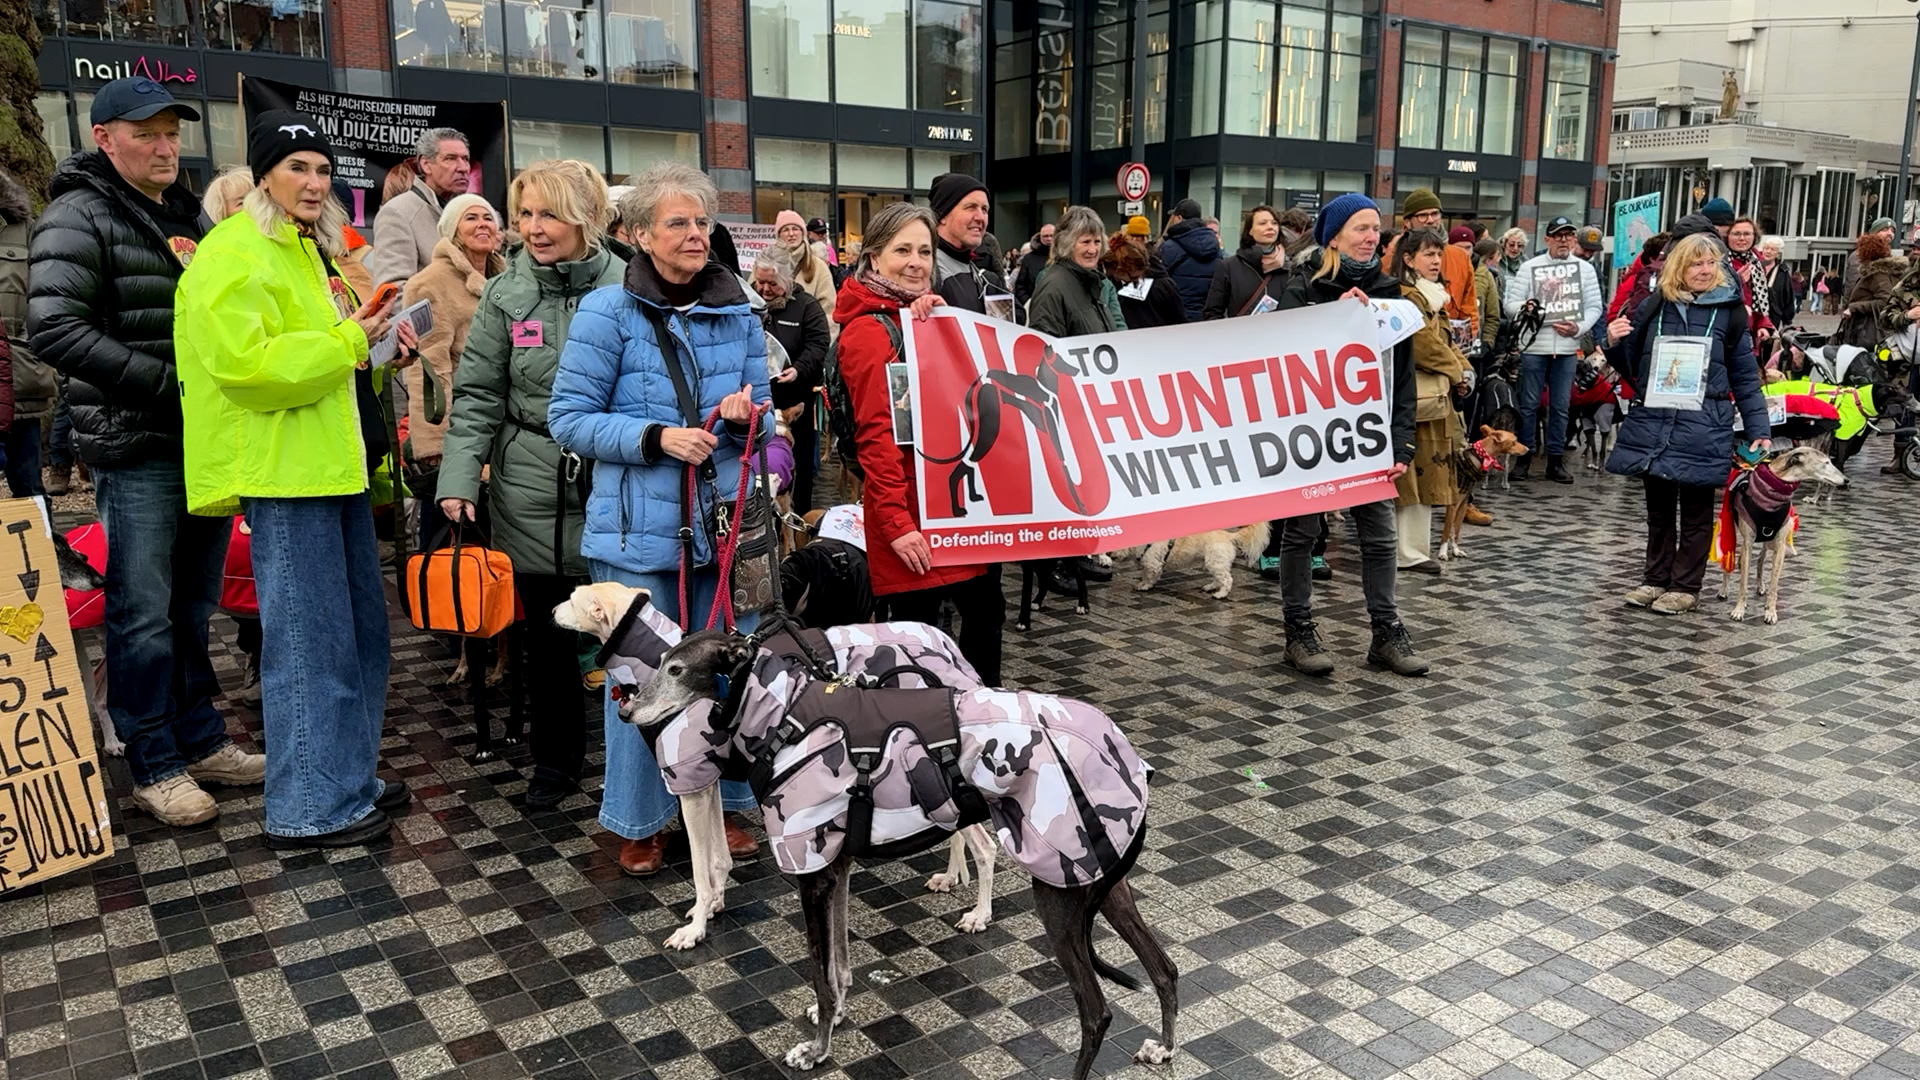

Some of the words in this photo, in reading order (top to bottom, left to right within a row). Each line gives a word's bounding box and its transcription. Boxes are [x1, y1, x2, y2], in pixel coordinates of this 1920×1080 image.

[296, 101, 346, 119] Eindigt
[348, 112, 370, 122] ook
[373, 114, 393, 125] het
[396, 116, 429, 127] leven
[298, 91, 316, 103] ALS
[318, 93, 336, 106] HET
[338, 96, 402, 115] JACHTSEIZOEN
[403, 104, 437, 117] EINDIGT
[343, 119, 428, 146] DUIZENDE
[1534, 264, 1578, 280] STOP
[1563, 283, 1580, 295] DE
[1081, 343, 1383, 444] HUNTING
[912, 316, 1111, 520] NO
[1068, 344, 1119, 378] TO
[1107, 438, 1241, 498] WITH
[1249, 412, 1388, 479] DOGS
[930, 531, 1014, 548] Defending
[1018, 529, 1044, 543] the
[1047, 524, 1124, 541] defenceless
